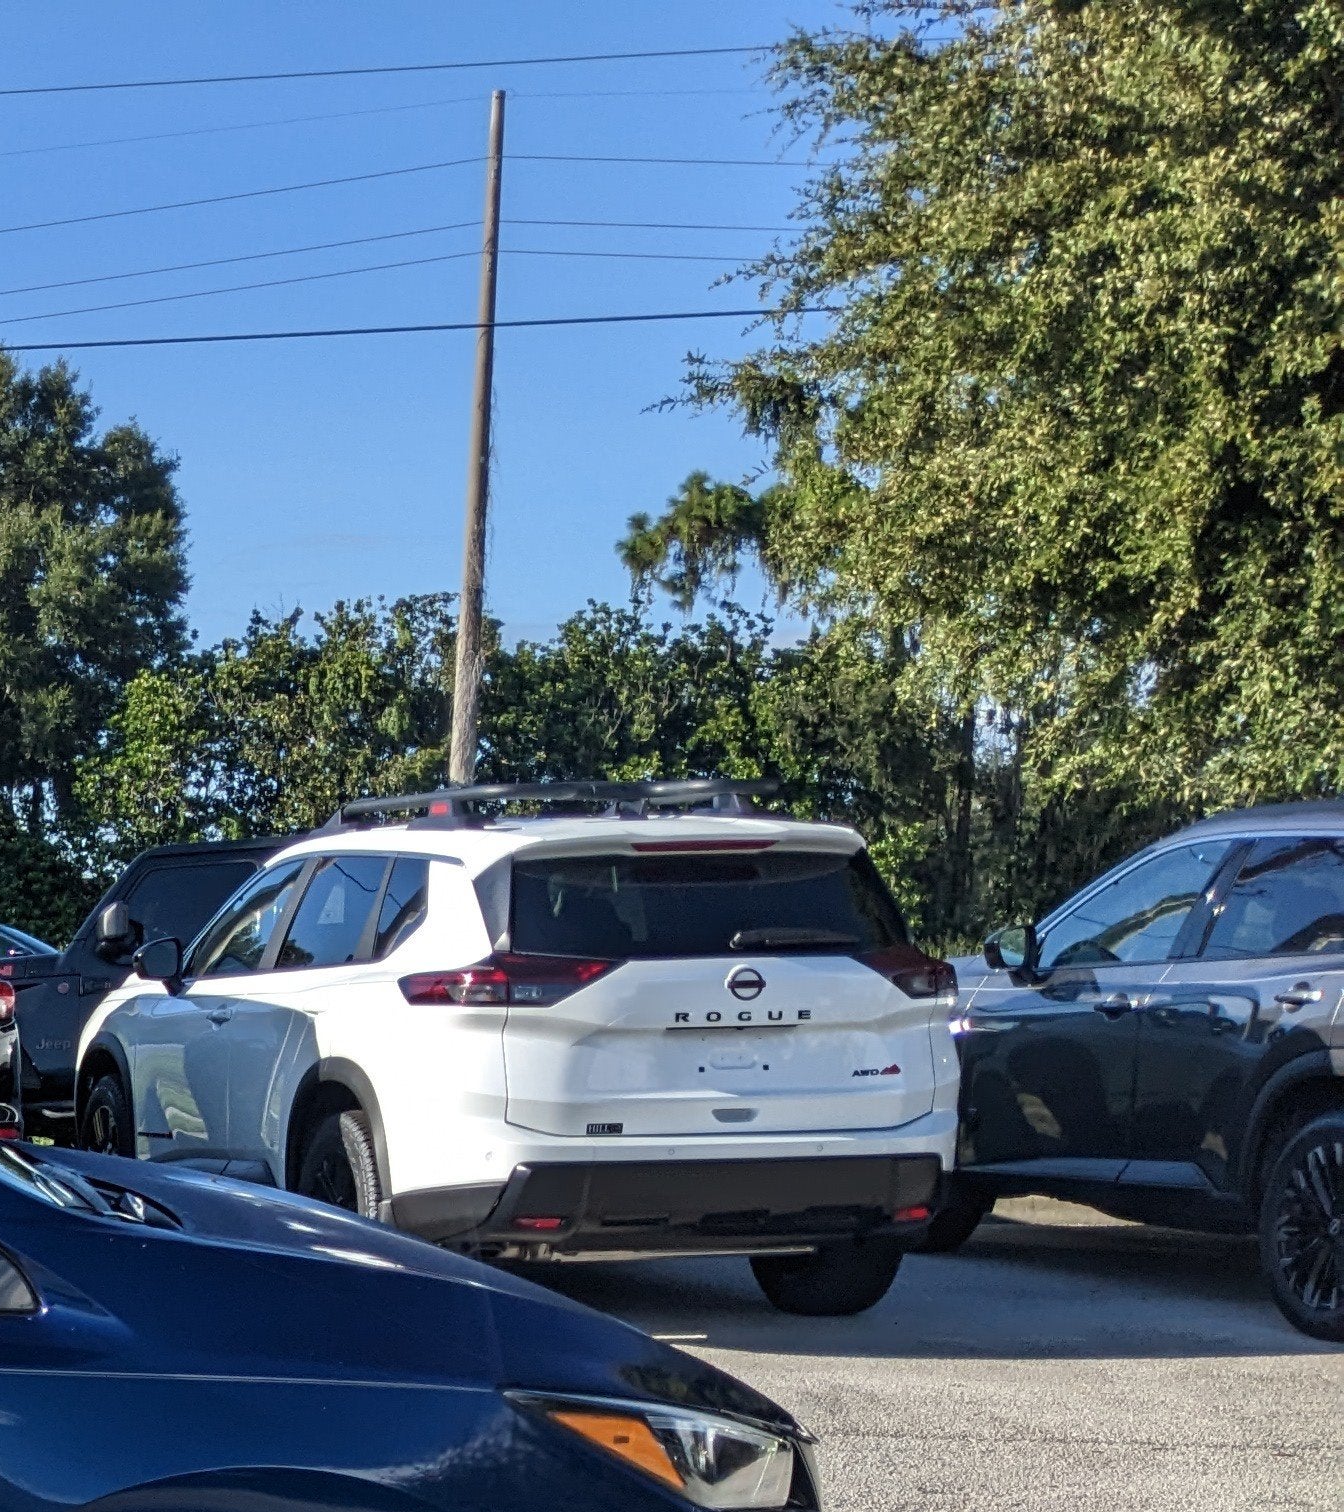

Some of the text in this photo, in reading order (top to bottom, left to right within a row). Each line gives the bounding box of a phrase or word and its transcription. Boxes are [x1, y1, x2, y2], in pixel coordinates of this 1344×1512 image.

[674, 1009, 812, 1023] ROGUE
[35, 1038, 71, 1050] Jeep
[851, 1069, 880, 1077] AWD
